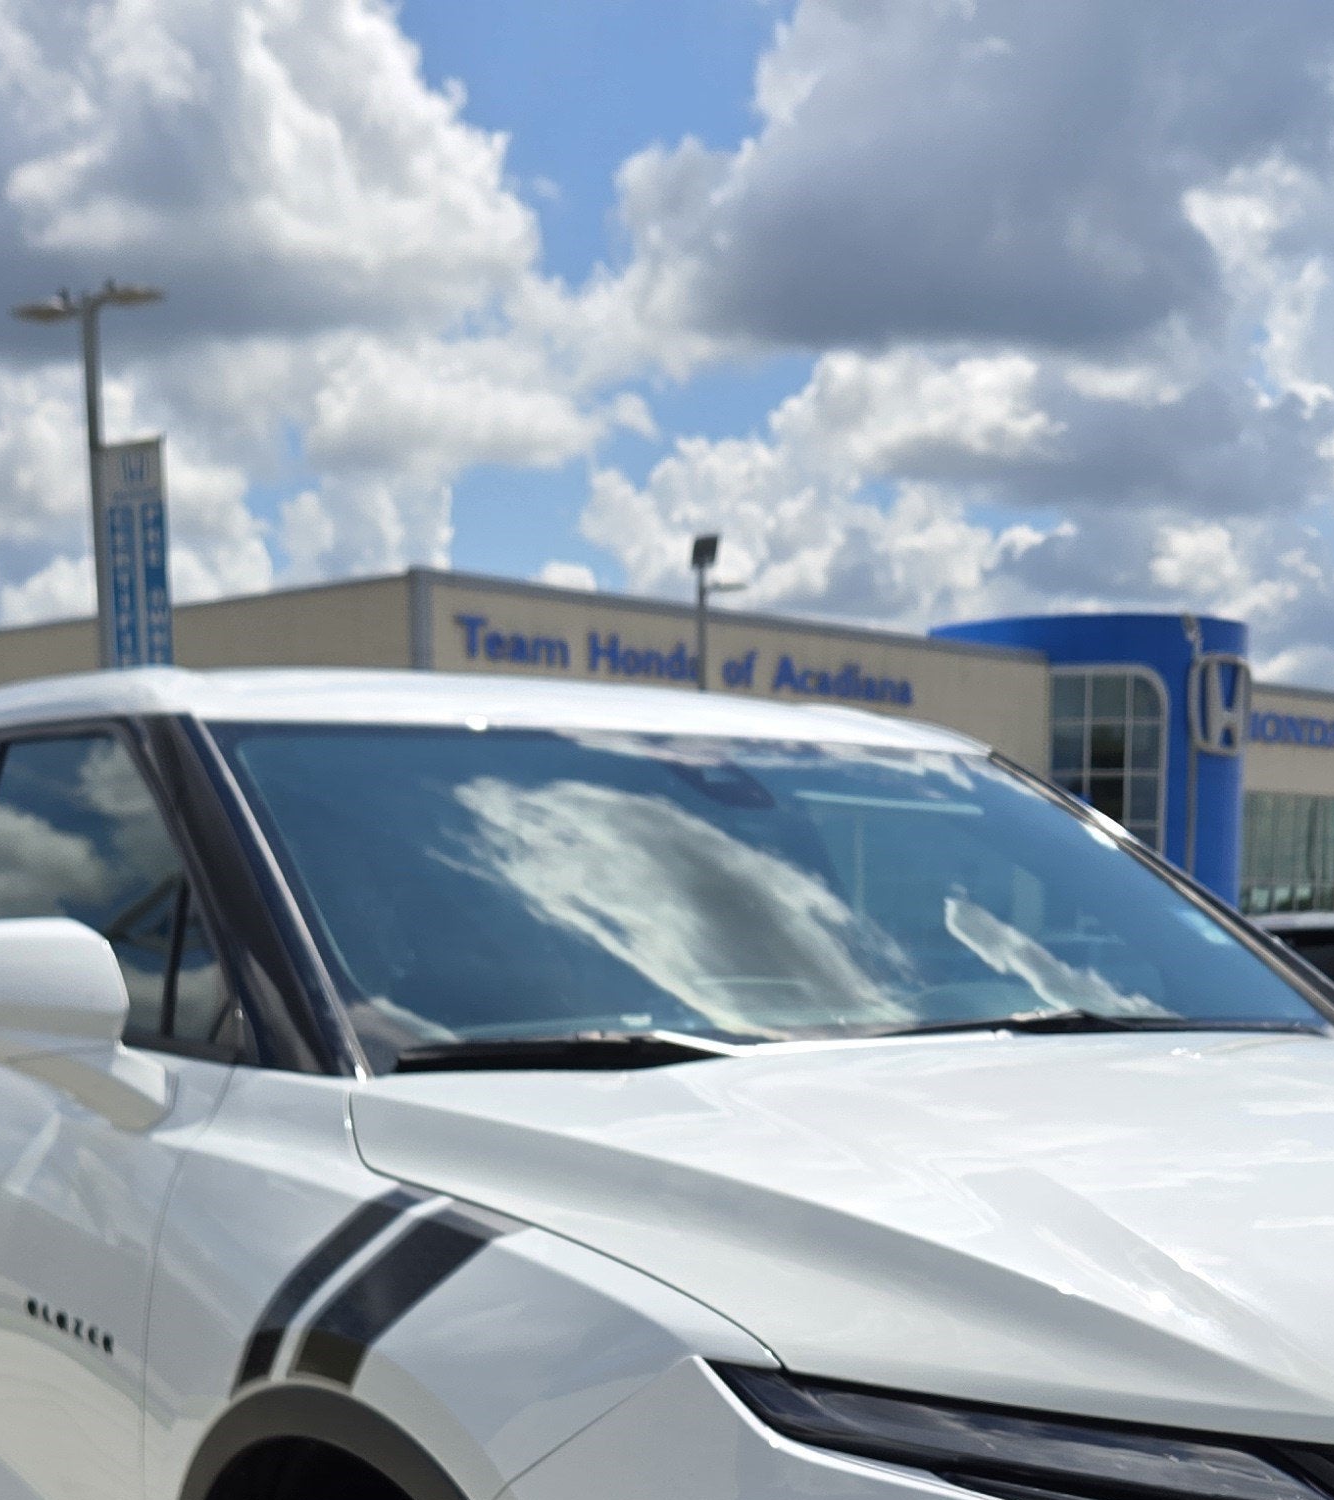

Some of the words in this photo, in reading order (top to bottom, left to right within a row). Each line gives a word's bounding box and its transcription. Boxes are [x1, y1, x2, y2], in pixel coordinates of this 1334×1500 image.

[454, 612, 571, 669] Team
[721, 647, 759, 688] of
[771, 653, 915, 707] Acadiana
